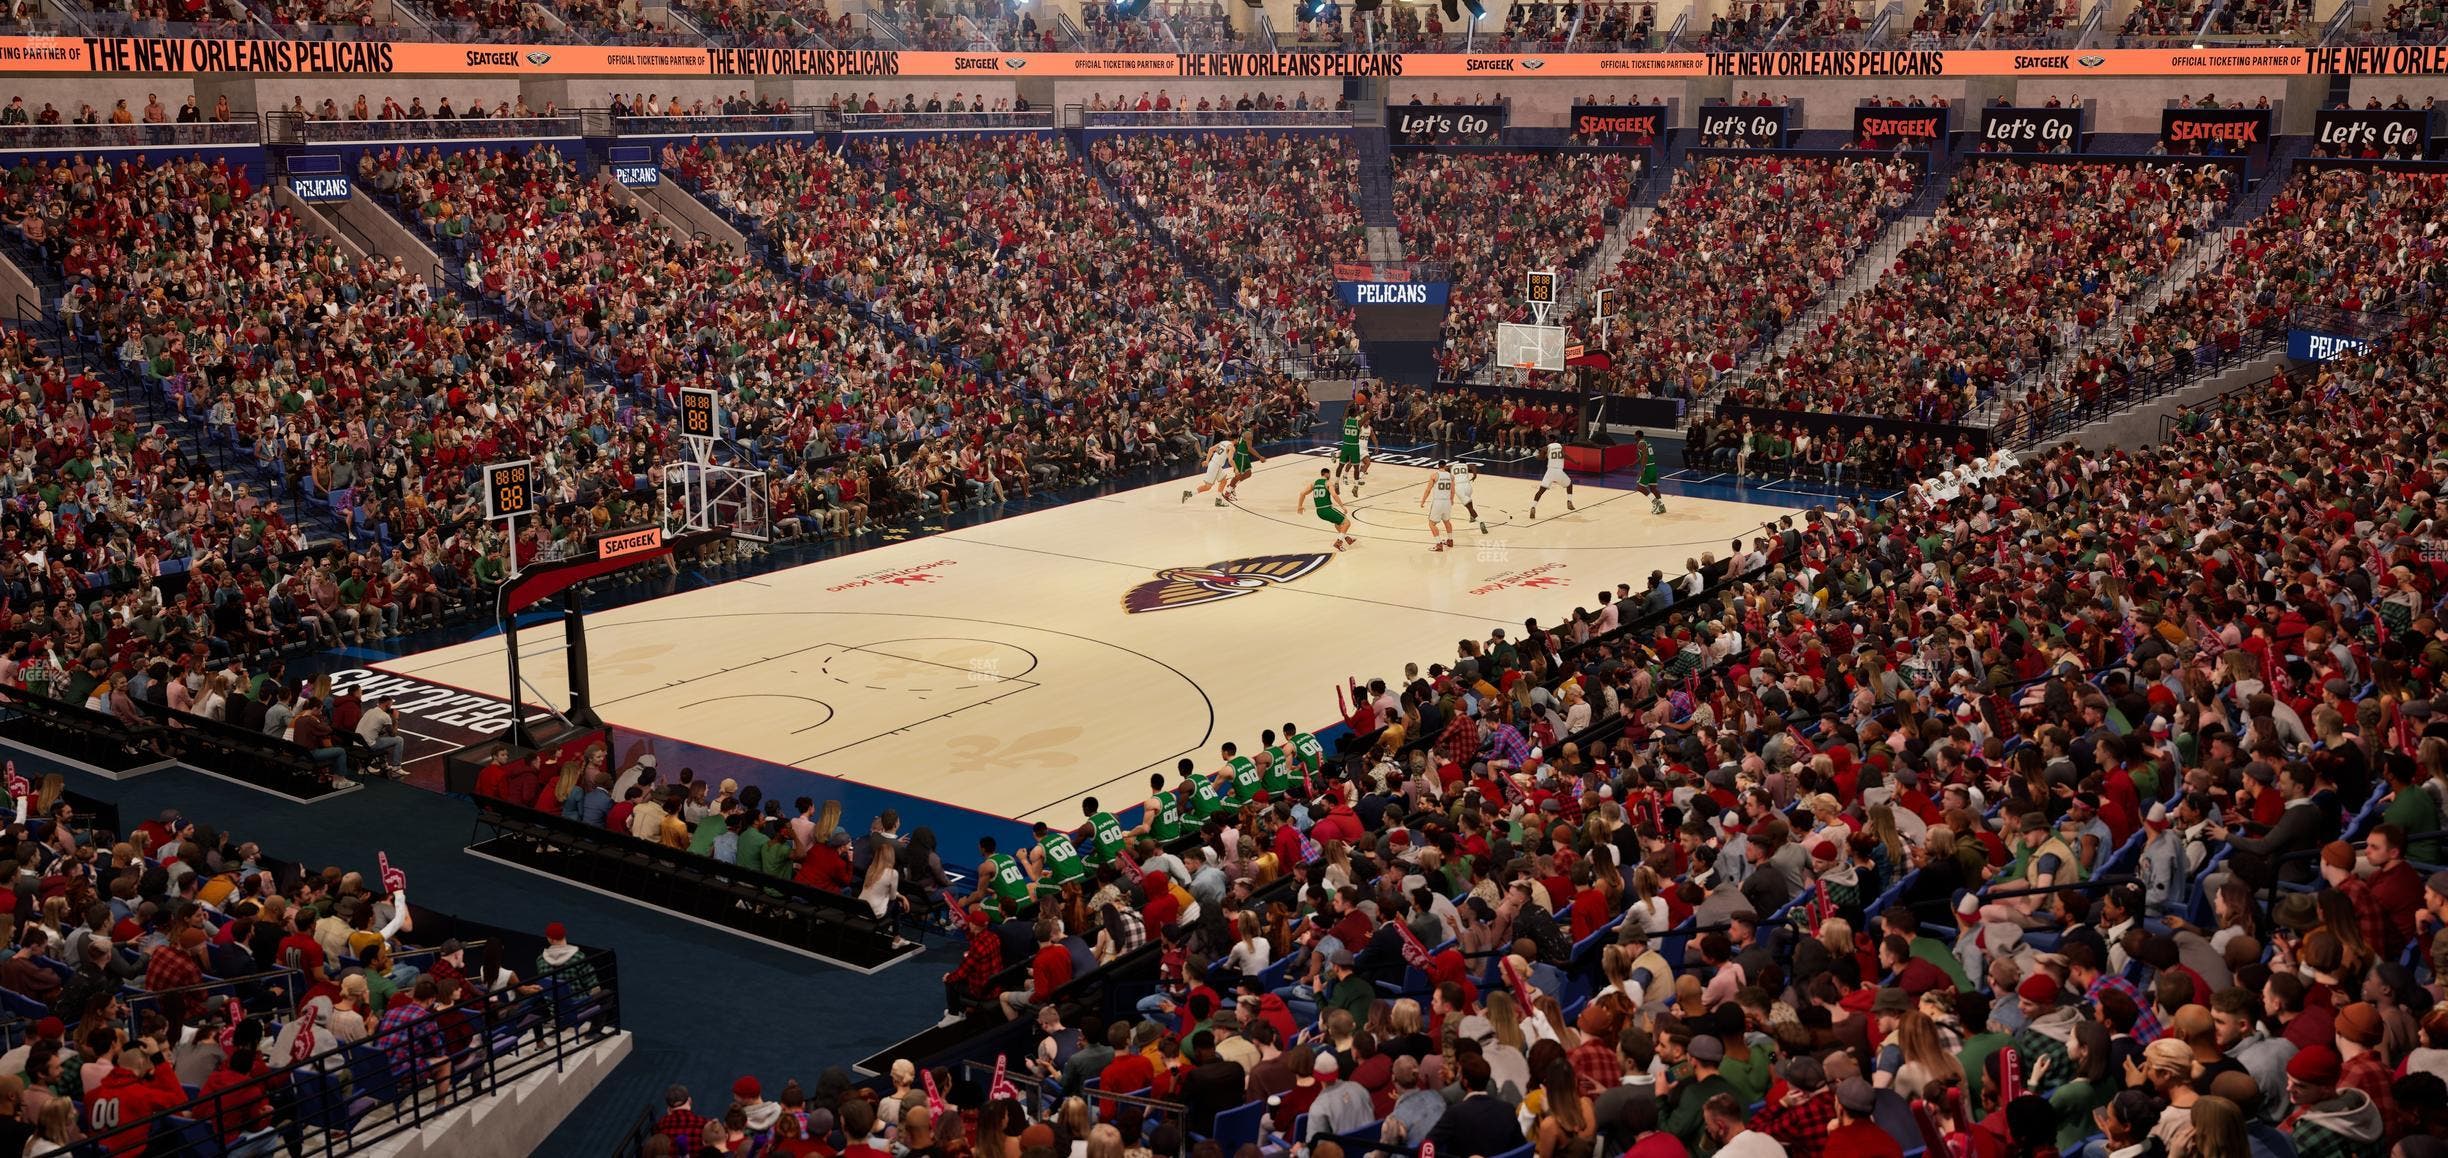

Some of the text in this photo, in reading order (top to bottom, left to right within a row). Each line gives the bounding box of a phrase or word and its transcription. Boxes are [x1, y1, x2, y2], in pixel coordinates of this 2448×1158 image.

[23, 47, 66, 60] PARTNER
[69, 48, 81, 60] OF
[83, 39, 393, 71] THE NEW ORLEANS PELICANS
[466, 51, 520, 67] SEATGEEK
[607, 55, 705, 66] OFFICIAL TICKETING PARTNER OF
[706, 49, 899, 75] THE NEW ORLEANS PELICANS
[955, 57, 999, 70] SEATGEEK
[2014, 55, 2069, 69] SEATGEEK
[2172, 56, 2301, 67] OFFICIAL TICKETING PARTNER OF
[2305, 46, 2448, 74] THE NEW ORLE
[1075, 60, 1174, 69] OFFICIAL TICKETING PARTNER OF
[1176, 55, 1402, 76] THE NEW ORLEANS PELICANS
[1466, 59, 1515, 71] SEATGEEK
[1601, 60, 1703, 69] OFFICIAL TICKETING PARTNER OF
[1706, 53, 1943, 75] THE NEW ORLEANS PELICANS
[1400, 114, 1489, 134] Let's Go
[1579, 114, 1656, 135] SEATGEEK
[1703, 116, 1778, 137] Let's Go
[1862, 117, 1938, 138] SEATGEEK
[1986, 118, 2073, 140] Let's Go
[2170, 120, 2258, 142] SEATGEEK
[2320, 121, 2418, 145] Let's Go
[616, 167, 656, 183] PELICANS
[296, 179, 347, 197] PELICANS
[1357, 284, 1427, 303] PELICANS
[685, 394, 710, 409] 88 88
[688, 410, 708, 431] 88
[495, 467, 525, 485] 88 88
[500, 485, 524, 511] 88
[605, 532, 656, 554] SEATGEEK
[1299, 738, 1324, 757] 00
[1238, 768, 1260, 786] 00
[1099, 825, 1124, 845] 00
[1048, 840, 1078, 862] 00
[1001, 865, 1024, 885] 00
[91, 1097, 120, 1130] 00
